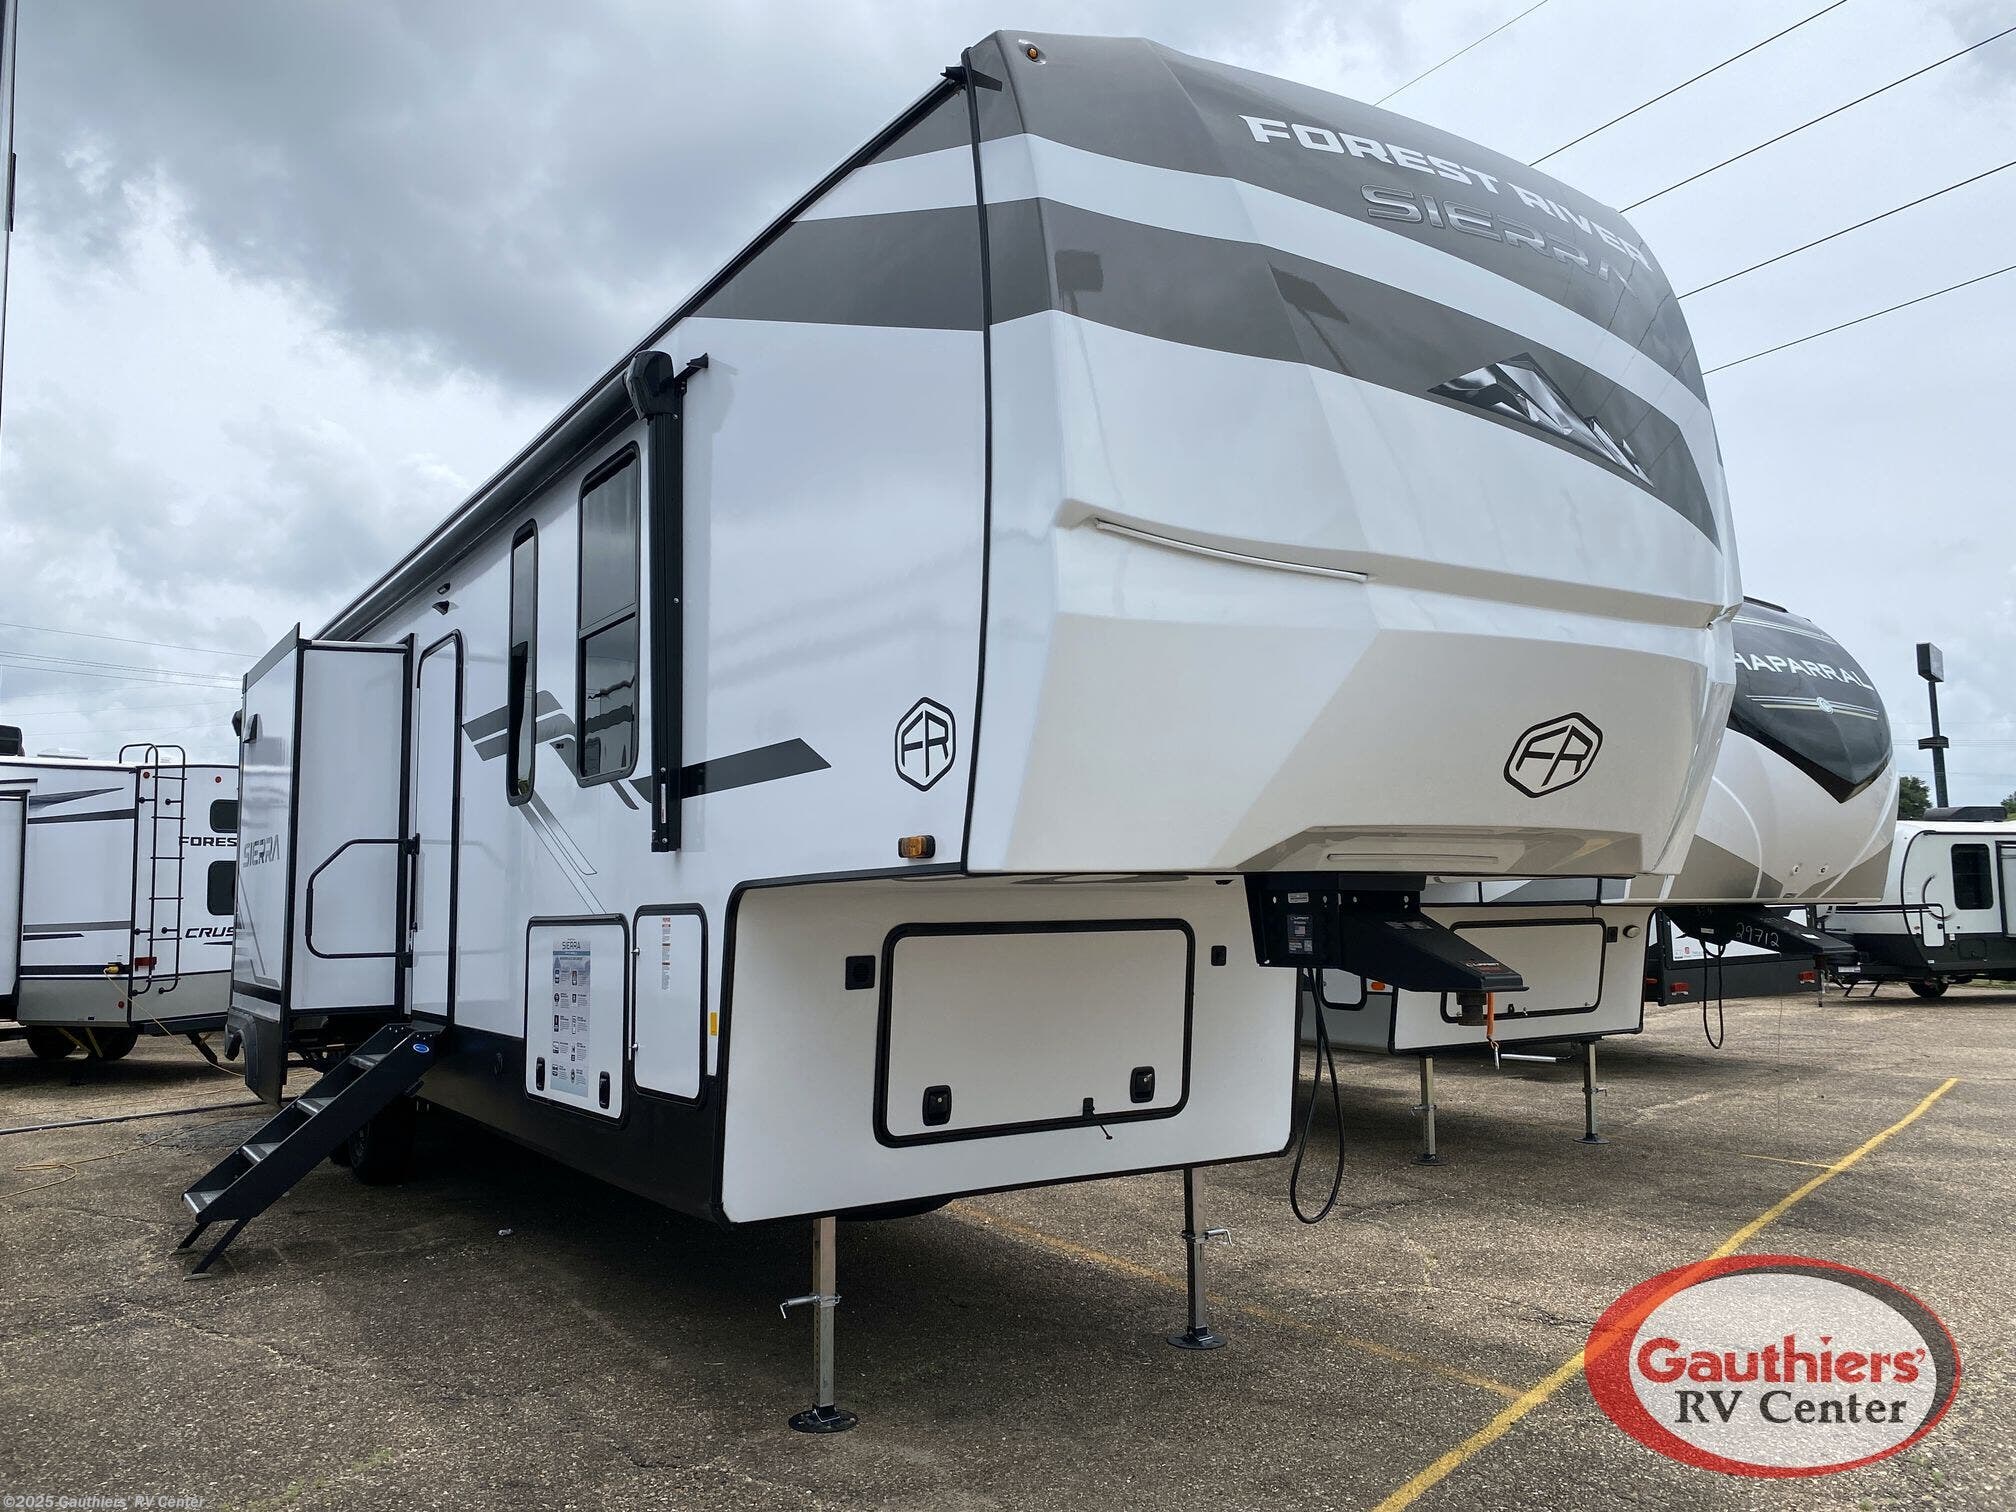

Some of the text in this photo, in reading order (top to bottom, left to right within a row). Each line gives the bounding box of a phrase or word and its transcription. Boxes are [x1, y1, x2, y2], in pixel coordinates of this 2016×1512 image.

[1238, 115, 1655, 272] FOREST RIVER
[1361, 184, 1640, 301] SIERRA
[243, 834, 280, 868] SIERRA
